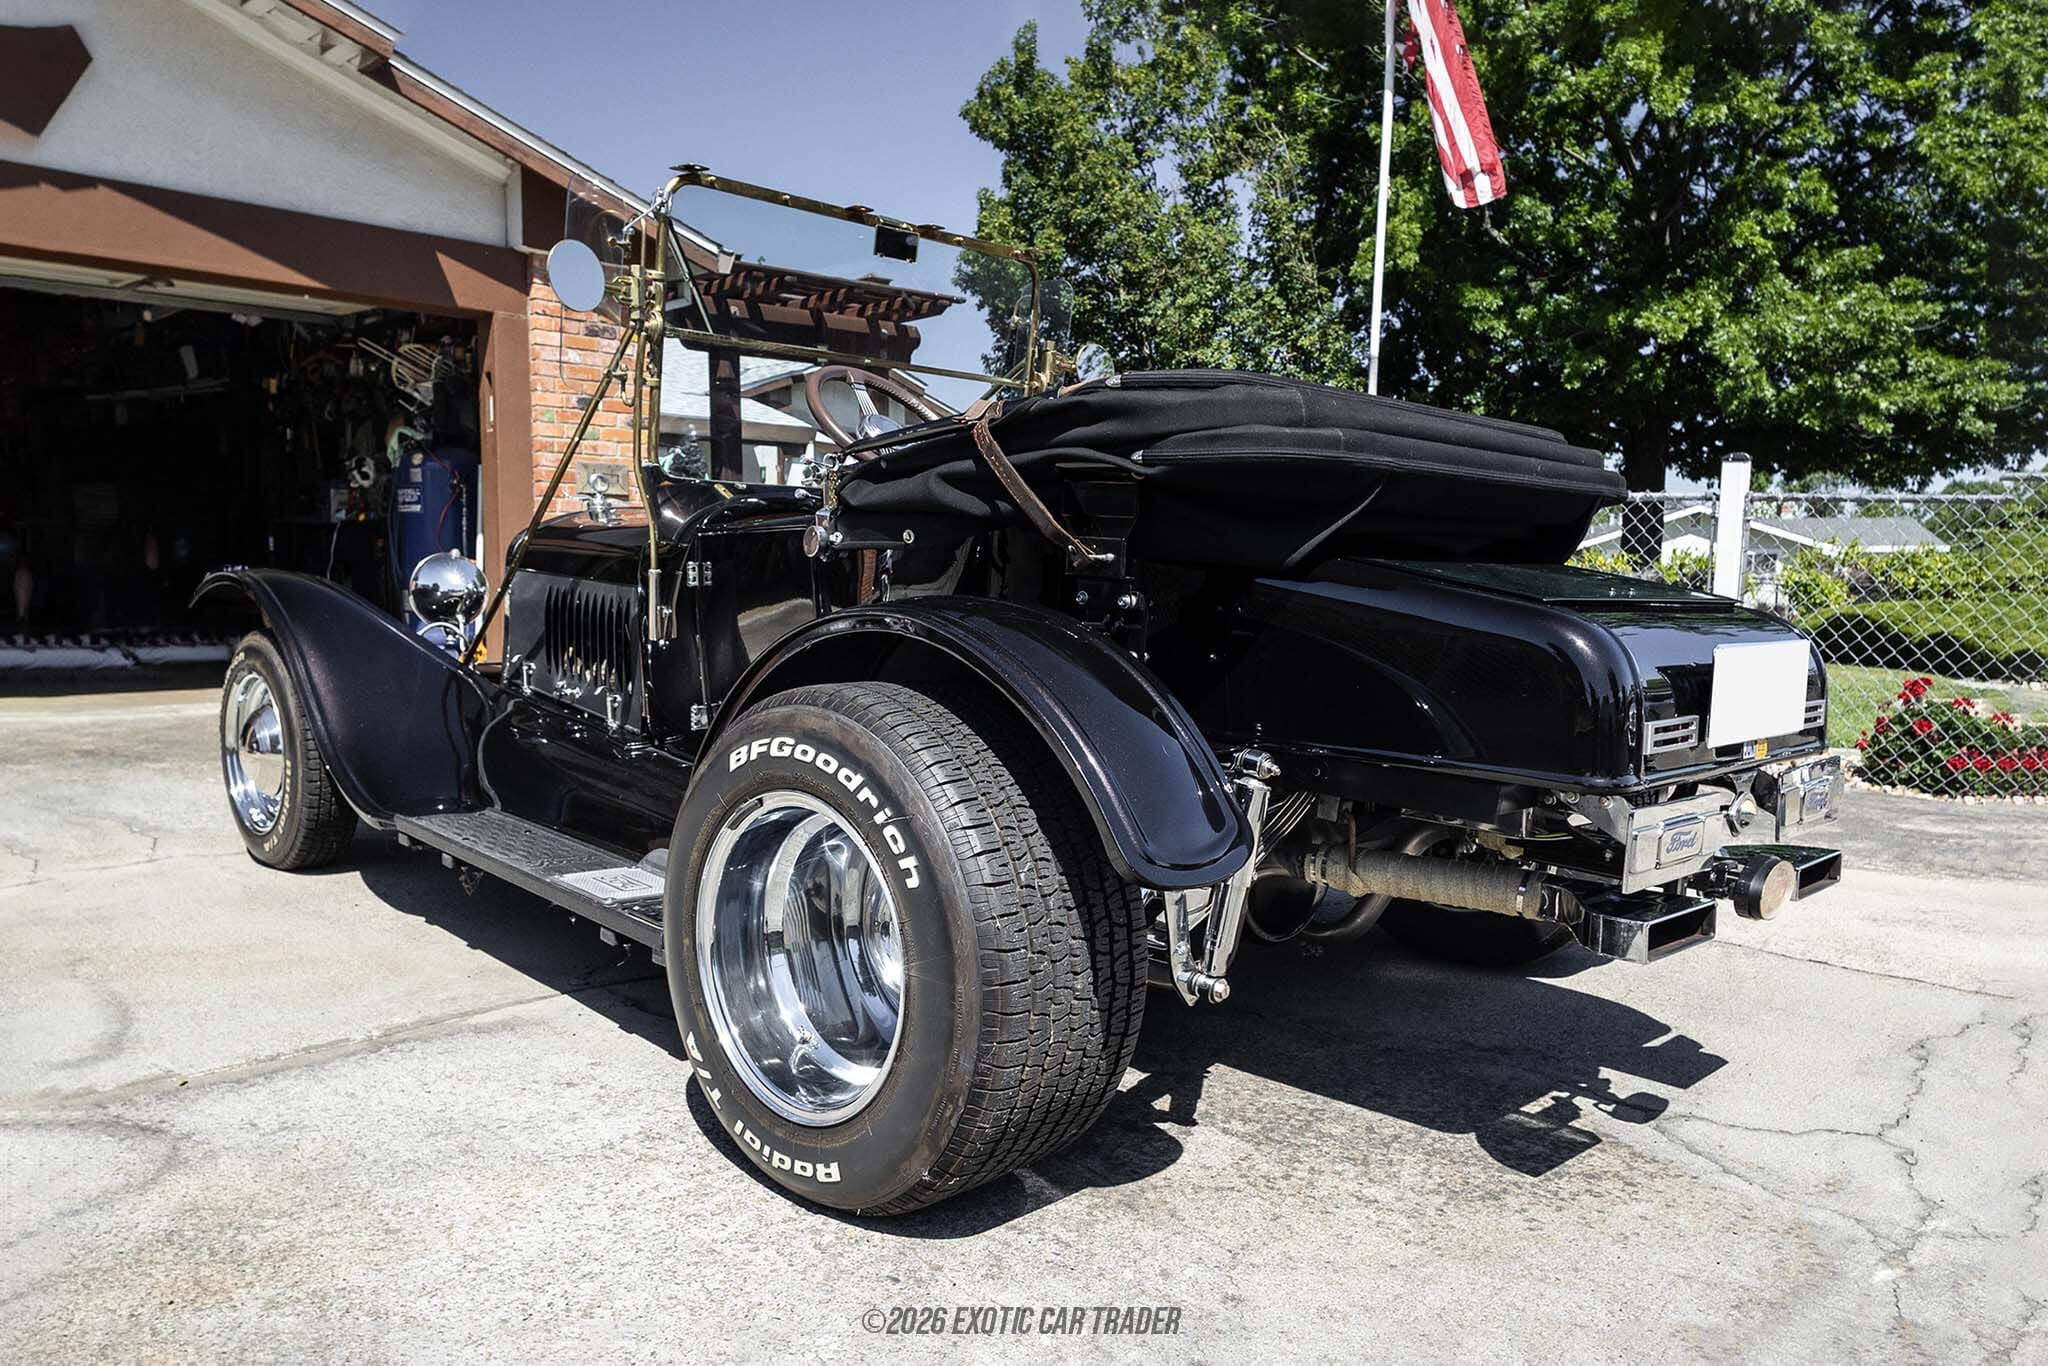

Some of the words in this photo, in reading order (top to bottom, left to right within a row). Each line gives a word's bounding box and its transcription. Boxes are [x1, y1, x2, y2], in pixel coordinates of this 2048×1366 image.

[729, 736, 920, 889] BFGoodrich
[1666, 830, 1697, 854] Ford
[686, 1031, 722, 1109] T/A
[733, 1119, 841, 1183] Radial
